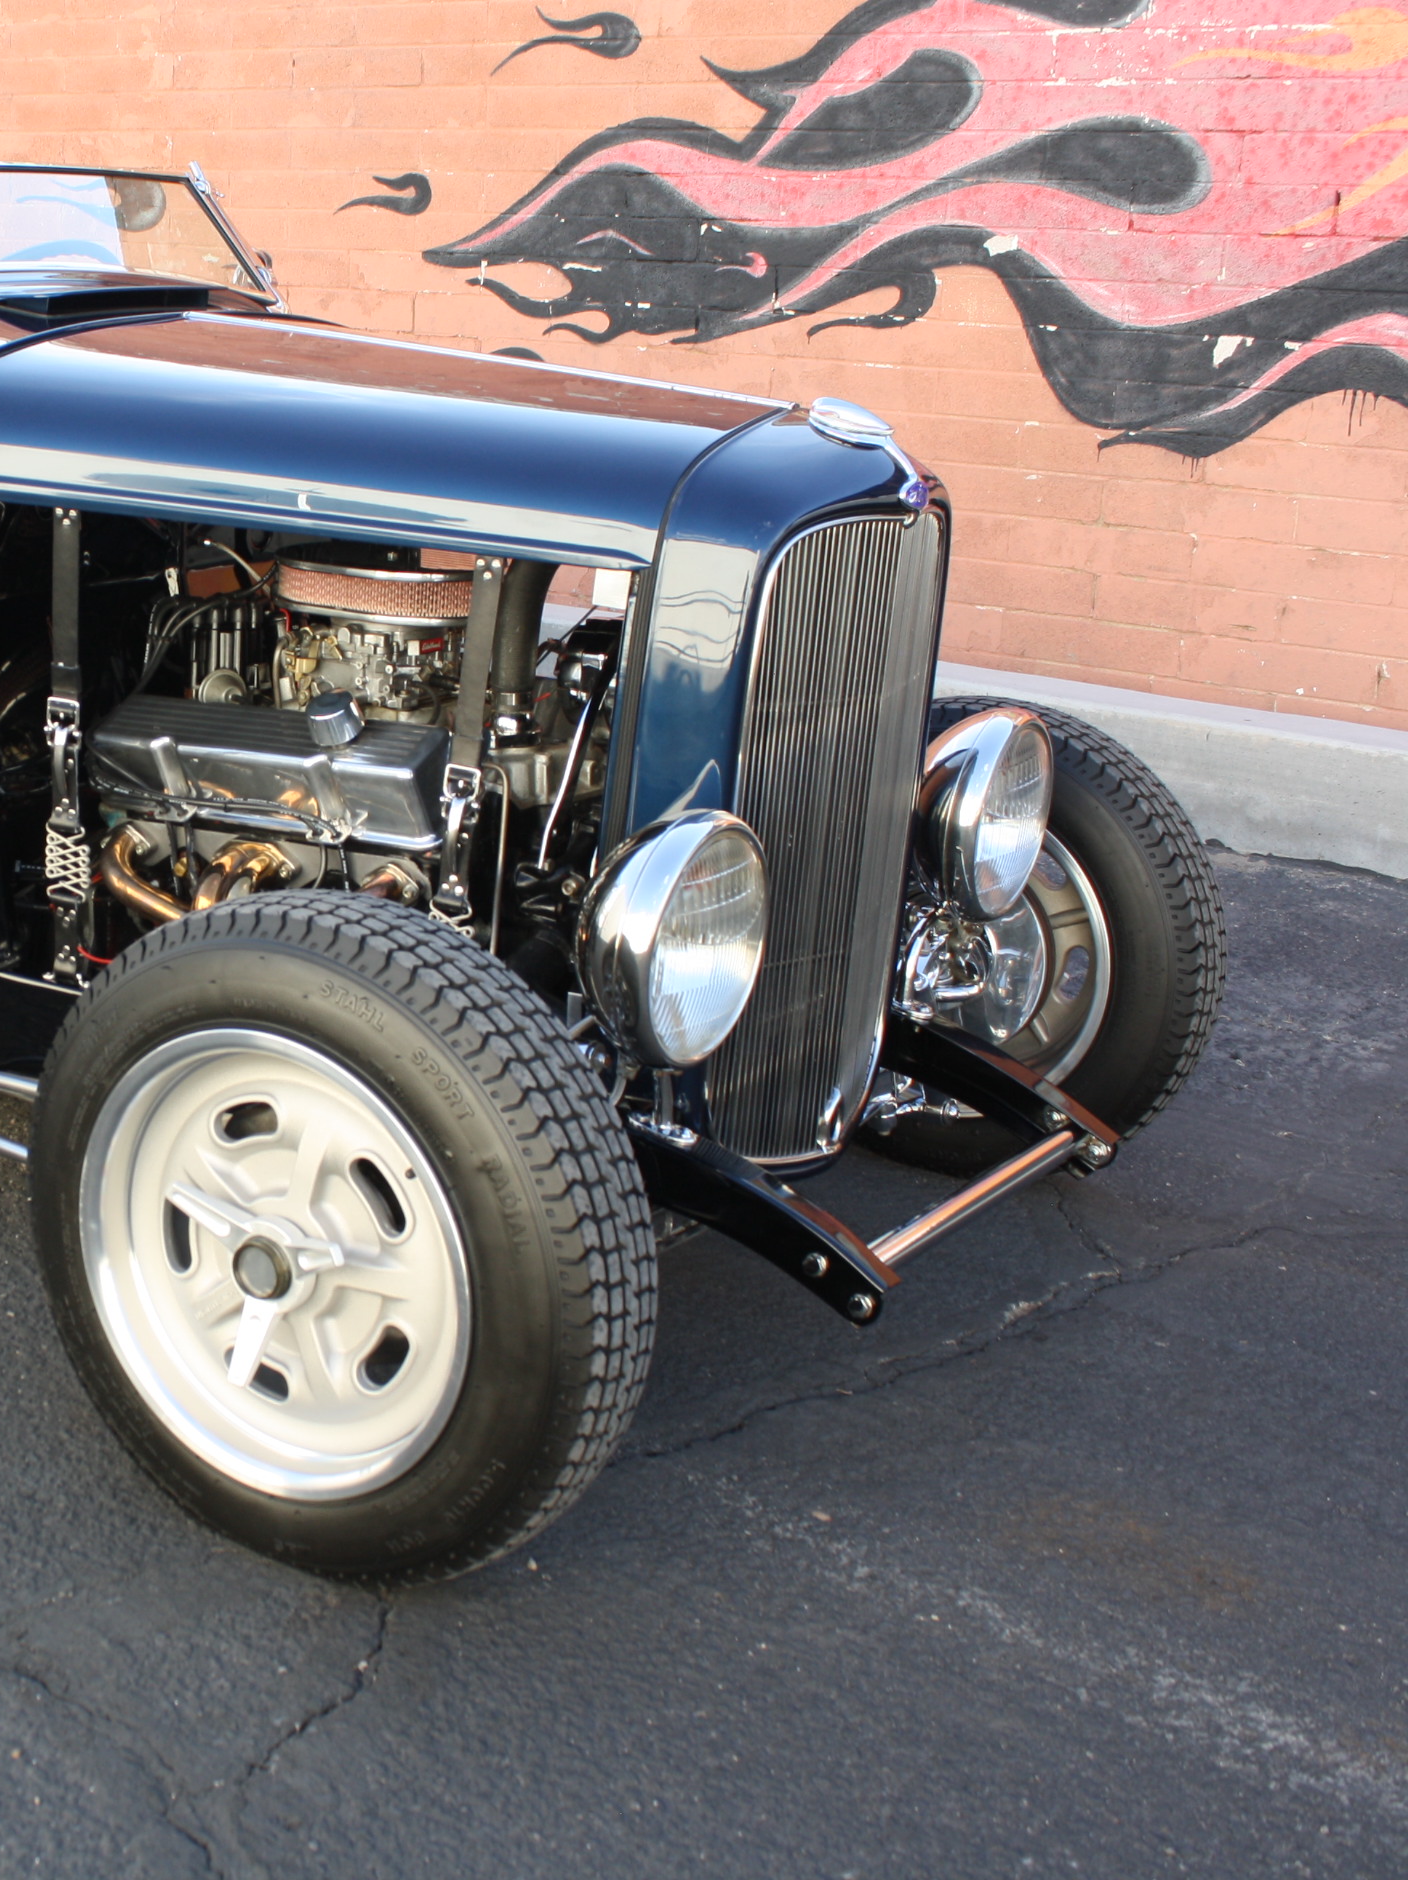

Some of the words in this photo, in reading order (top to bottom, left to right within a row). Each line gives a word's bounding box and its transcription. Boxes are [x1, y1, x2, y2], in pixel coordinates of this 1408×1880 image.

[320, 980, 384, 1032] STAHL
[410, 1047, 475, 1120] SPORT
[483, 1153, 529, 1255] RADIAL
